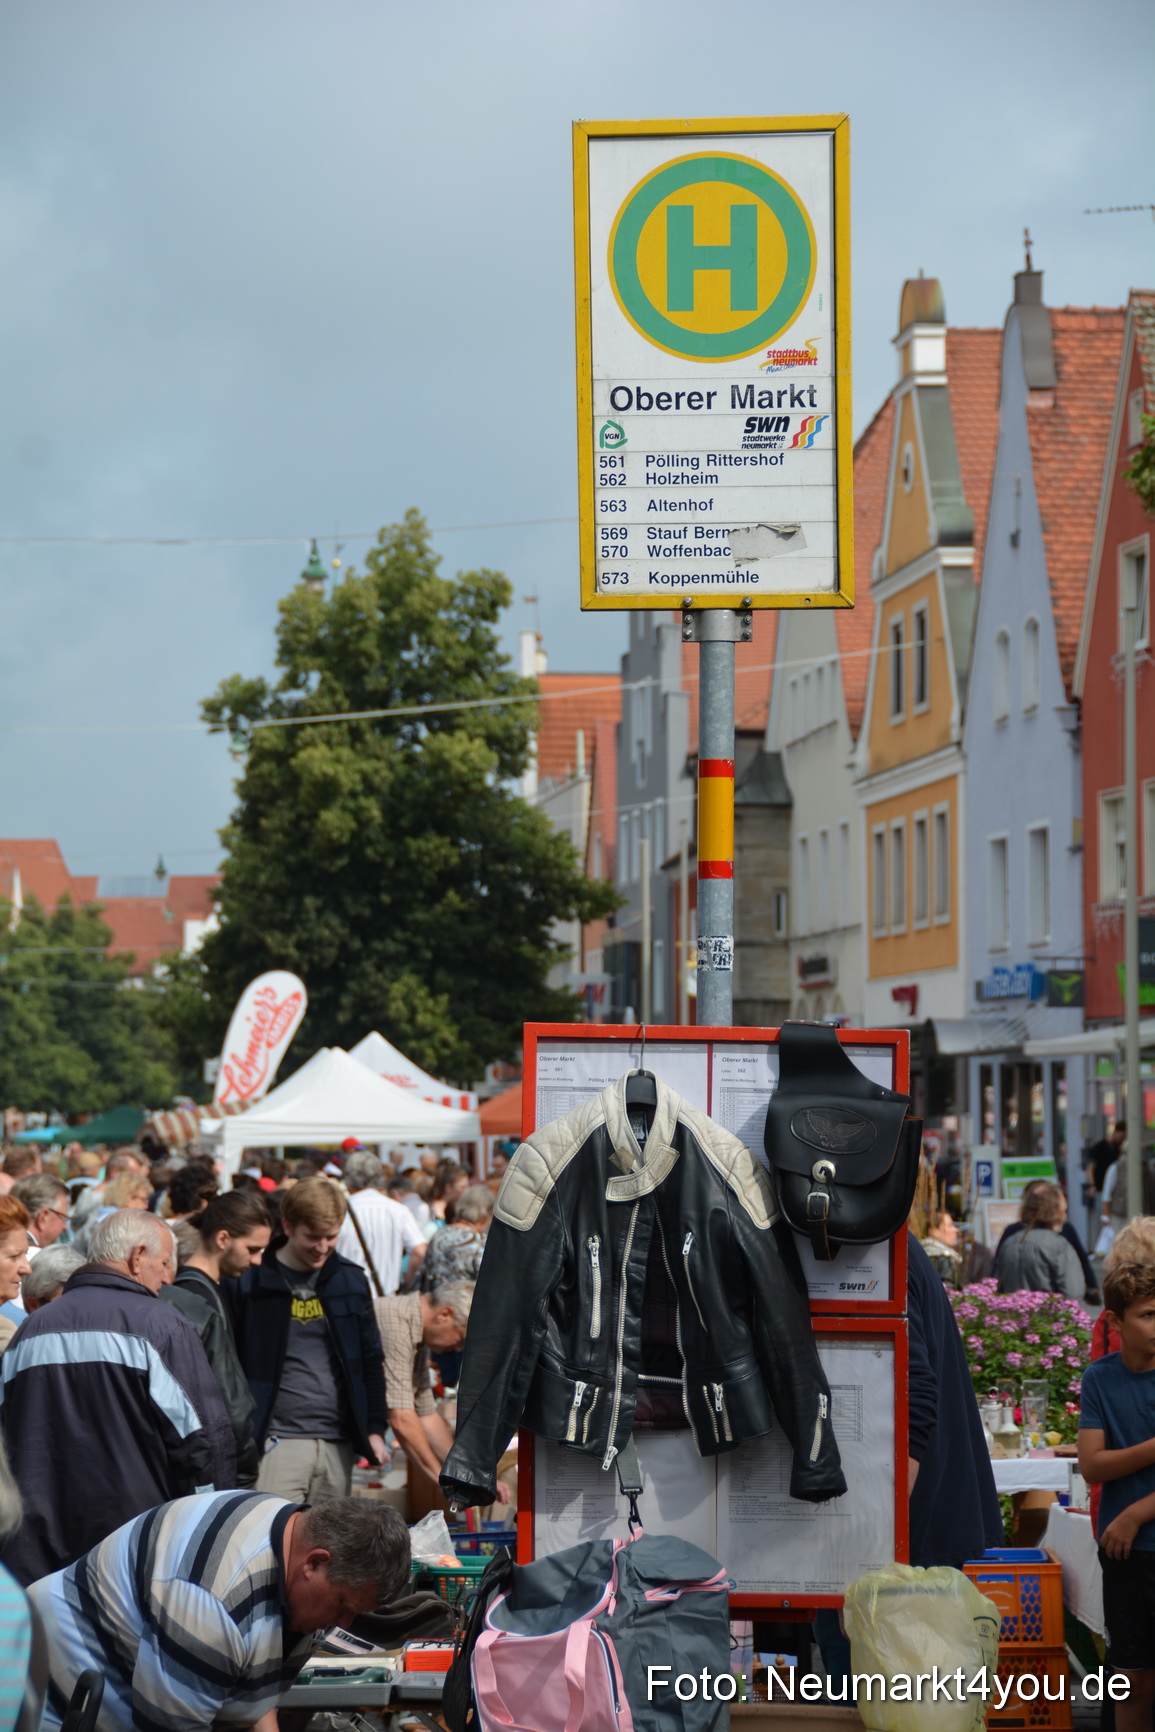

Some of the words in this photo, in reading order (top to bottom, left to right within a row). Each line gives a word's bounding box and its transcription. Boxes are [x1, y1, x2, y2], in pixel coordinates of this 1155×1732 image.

[666, 204, 758, 312] H
[767, 348, 810, 359] stadtbus
[772, 356, 819, 367] neumarkt
[609, 385, 718, 411] Oberer
[730, 383, 818, 410] Markt
[743, 415, 791, 434] swn
[604, 432, 620, 440] VGN
[742, 434, 786, 443] stadtwerke
[741, 442, 777, 450] neumarkt
[599, 455, 625, 468] 561
[645, 454, 700, 470] Pölling
[706, 452, 784, 467] Rittershof
[599, 473, 627, 486] 562
[645, 472, 719, 485] Holzheim
[600, 500, 627, 512] 563
[647, 498, 714, 512] Altenhof
[600, 527, 628, 540] 569
[647, 526, 689, 540] Stauf
[694, 526, 736, 539] Bern
[601, 545, 629, 558] 570
[647, 543, 732, 558] Woffenbac
[601, 572, 630, 585] 573
[648, 570, 760, 587] Koppenmühle
[539, 1055, 558, 1063] Oberer
[838, 1281, 866, 1290] swn
